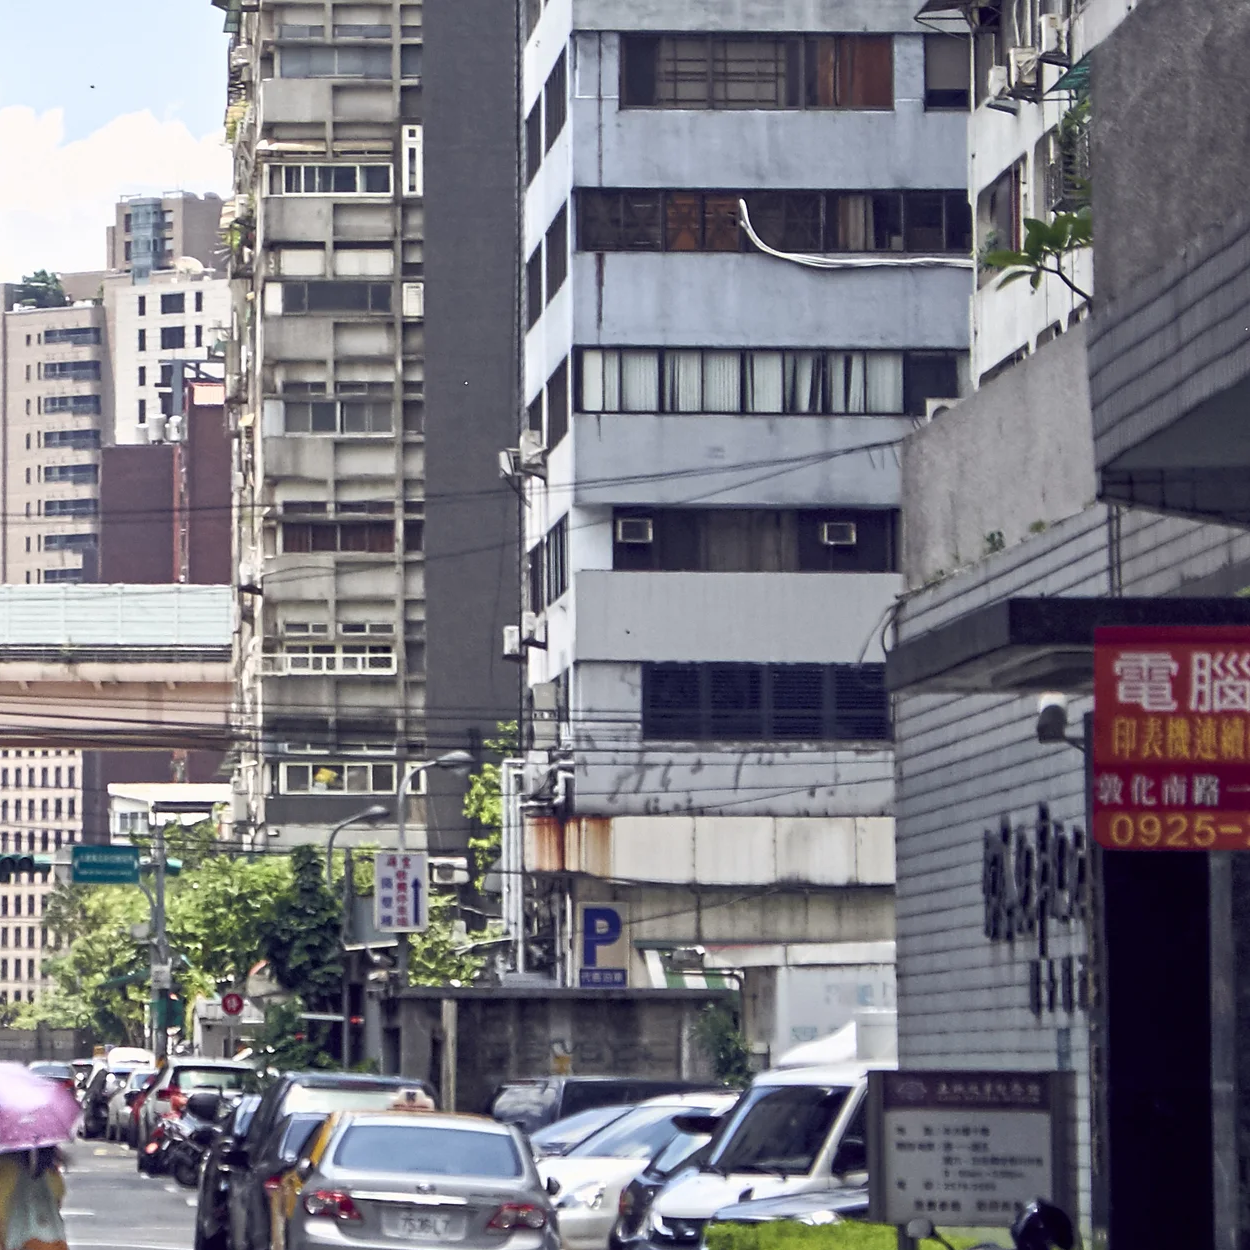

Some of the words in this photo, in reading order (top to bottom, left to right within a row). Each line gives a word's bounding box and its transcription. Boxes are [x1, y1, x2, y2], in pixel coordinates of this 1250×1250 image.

[1114, 652, 1250, 712] 電腦
[1110, 814, 1250, 847] 0925-
[583, 908, 622, 967] P
